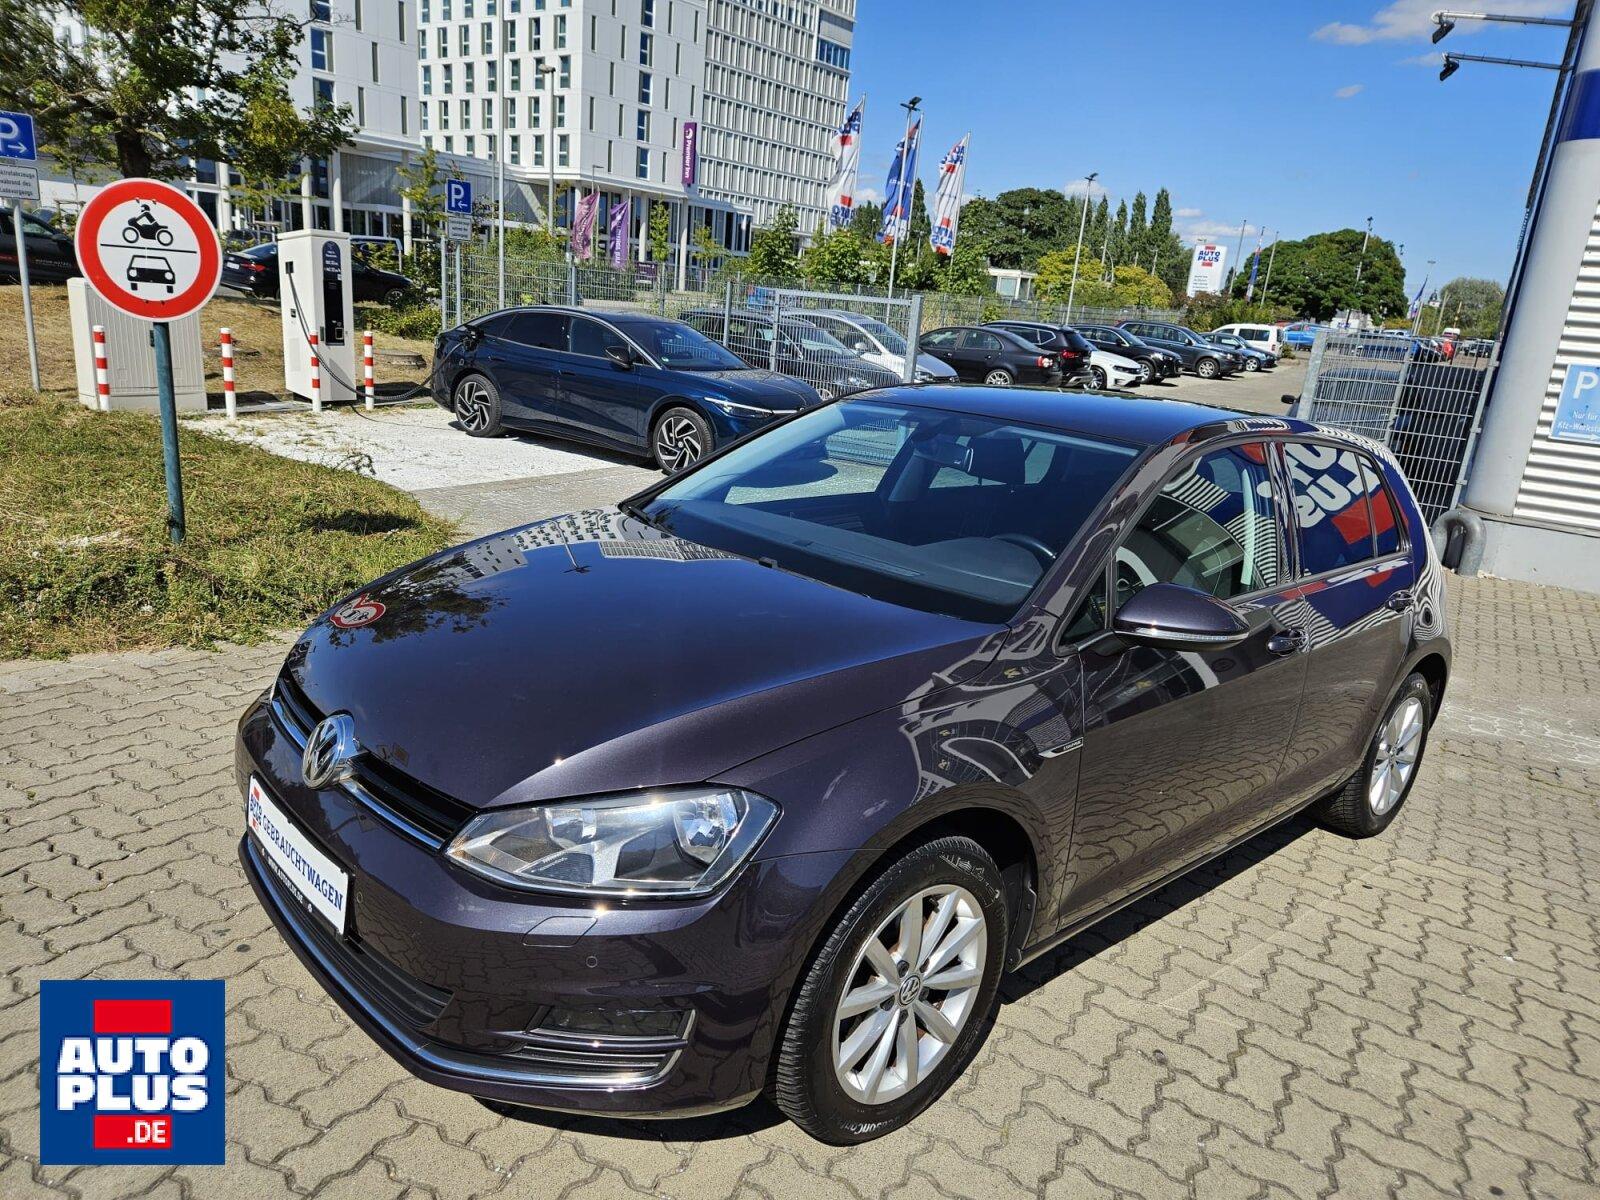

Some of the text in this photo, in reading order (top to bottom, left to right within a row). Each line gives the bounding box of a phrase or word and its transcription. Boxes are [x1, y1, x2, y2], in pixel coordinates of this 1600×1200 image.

[451, 184, 465, 208] P
[1573, 371, 1599, 399] P
[262, 815, 344, 911] GEBRAUCHTWAGEN
